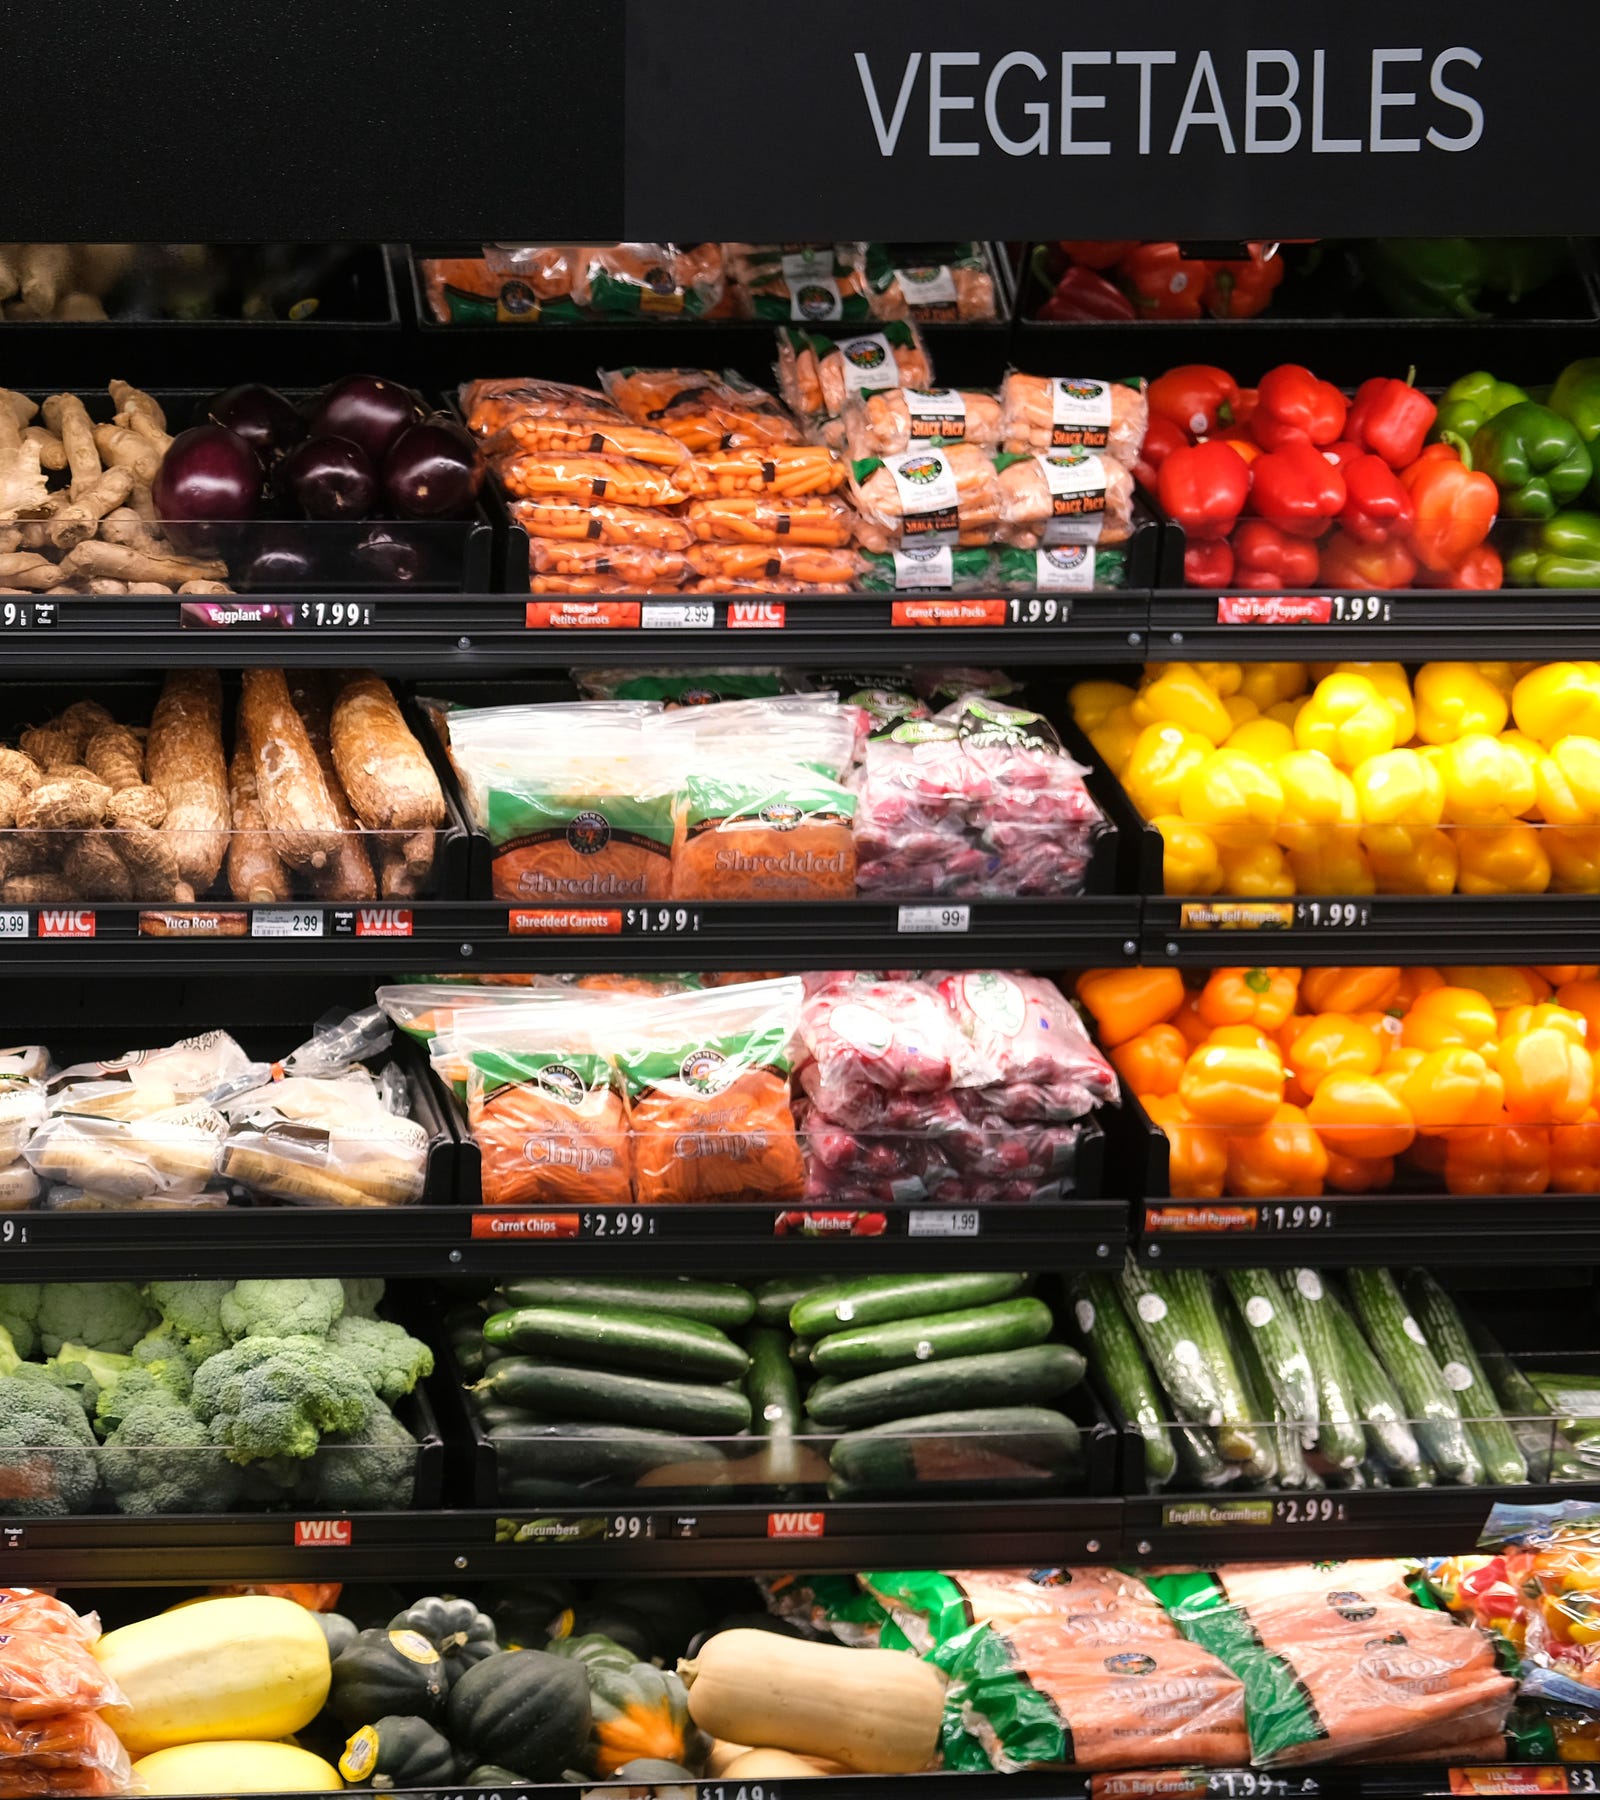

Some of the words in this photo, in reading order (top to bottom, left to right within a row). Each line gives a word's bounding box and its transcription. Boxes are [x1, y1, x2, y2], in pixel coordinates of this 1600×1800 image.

[854, 46, 1485, 157] VEGETABLES
[1052, 430, 1082, 446] SNACK
[1083, 430, 1106, 446] PACK
[1054, 499, 1082, 515] SNACK
[1083, 495, 1106, 513] PACK
[211, 608, 262, 624] Eggplant
[301, 603, 360, 626] $1.99
[563, 603, 598, 614] Packaged
[684, 606, 709, 622] 2.99
[733, 601, 781, 621] WIC
[905, 607, 933, 618] Carrot
[934, 607, 960, 618] Snack
[961, 606, 987, 617] Packs
[1009, 599, 1058, 623] 1.99
[1232, 604, 1251, 616] Red
[1252, 603, 1270, 615] Bell
[1270, 604, 1313, 618] Peppers
[1333, 597, 1379, 621] 1.99
[550, 614, 579, 625] Petite
[580, 614, 610, 625] Carrots
[715, 848, 846, 874] Shredded
[518, 870, 648, 895] Shredded
[42, 910, 91, 931] WIC
[164, 916, 190, 929] Yuca
[192, 915, 218, 928] Root
[293, 915, 318, 931] 2.99
[360, 909, 409, 929] WIC
[515, 915, 568, 929] Shredded
[569, 914, 608, 927] Carrots
[627, 909, 688, 931] $1.99
[1188, 910, 1219, 922] Yellow
[1221, 910, 1241, 921] Bell
[1242, 910, 1281, 924] Peppers
[1298, 903, 1357, 926] $1.99
[675, 1125, 768, 1160] Chips
[523, 1137, 614, 1173] Chips
[491, 1218, 525, 1231] Carrot
[526, 1219, 557, 1233] Chips
[584, 1212, 643, 1236] $2.99
[804, 1216, 852, 1230] Radishes
[952, 1214, 975, 1231] 1.99
[1150, 1214, 1185, 1227] Orange
[1187, 1212, 1207, 1225] Bell
[1208, 1213, 1246, 1227] Peppers
[1262, 1205, 1321, 1229] $1.99
[1169, 1508, 1207, 1524] English
[1209, 1506, 1267, 1521] Cucumbers
[1277, 1498, 1333, 1523] $2.99
[300, 1520, 348, 1539] WIC
[521, 1523, 579, 1536] Cucumbers
[608, 1516, 641, 1538] .99
[773, 1513, 820, 1532] WIC
[1104, 1782, 1111, 1794] 2
[1132, 1781, 1154, 1797] Bag
[1156, 1779, 1195, 1793] Carrots
[1208, 1773, 1271, 1797] $1.99
[1502, 1782, 1540, 1793] Peppers
